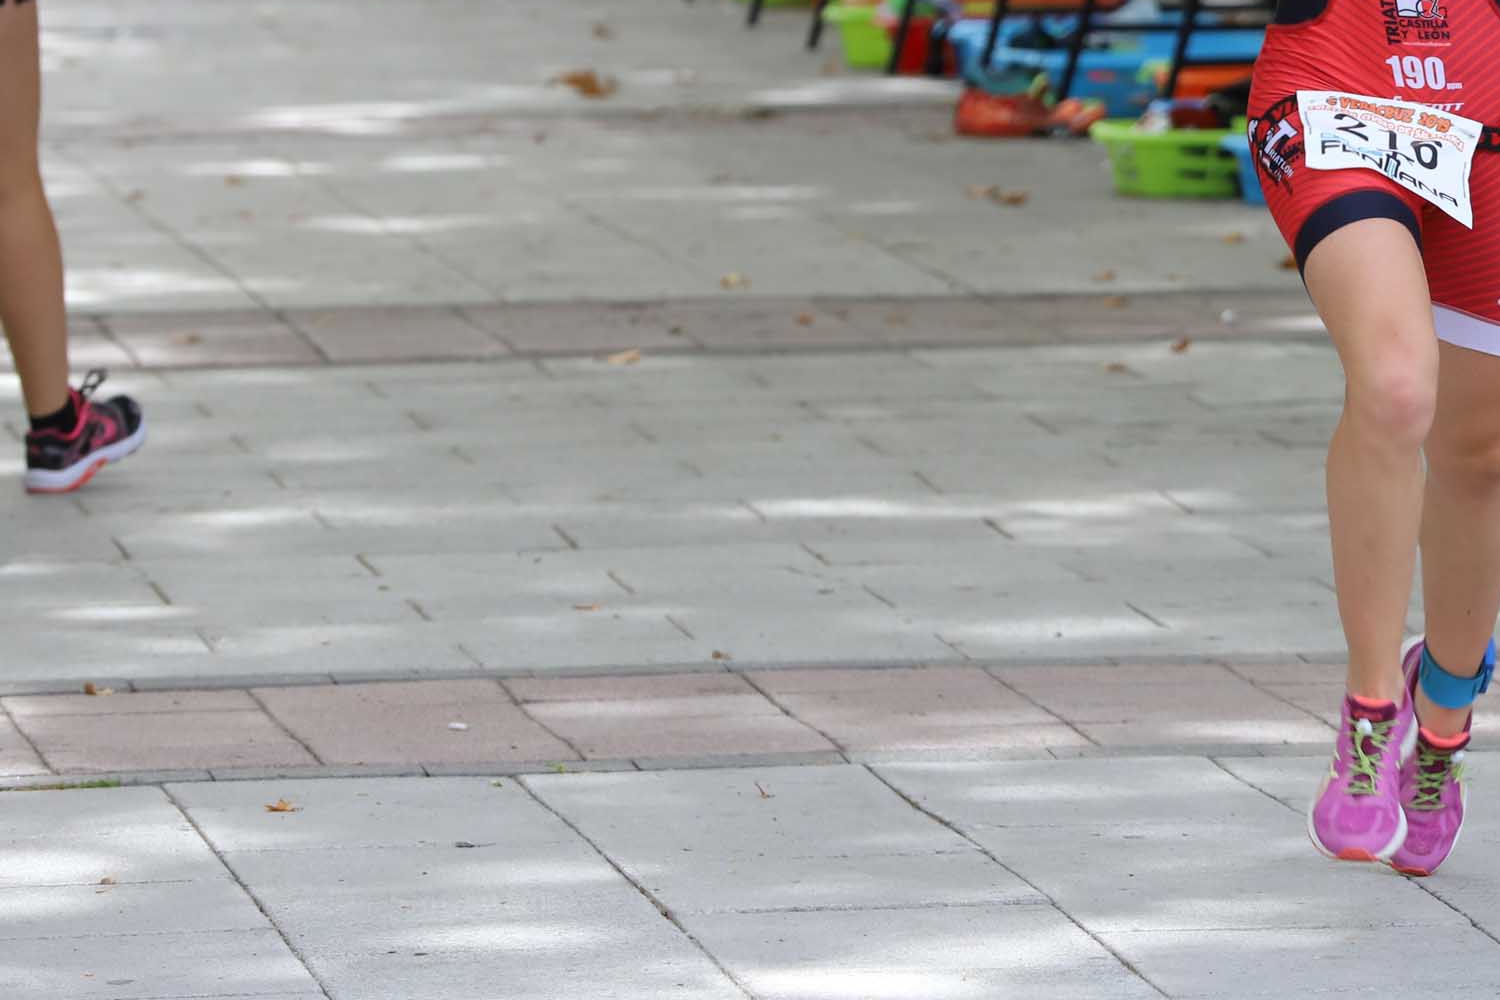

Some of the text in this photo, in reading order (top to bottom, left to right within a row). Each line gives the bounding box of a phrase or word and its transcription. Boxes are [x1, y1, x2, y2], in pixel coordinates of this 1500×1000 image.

[1400, 19, 1449, 29] CASTILLA
[1401, 30, 1409, 39] Y
[1339, 96, 1416, 123] VERACRUZ
